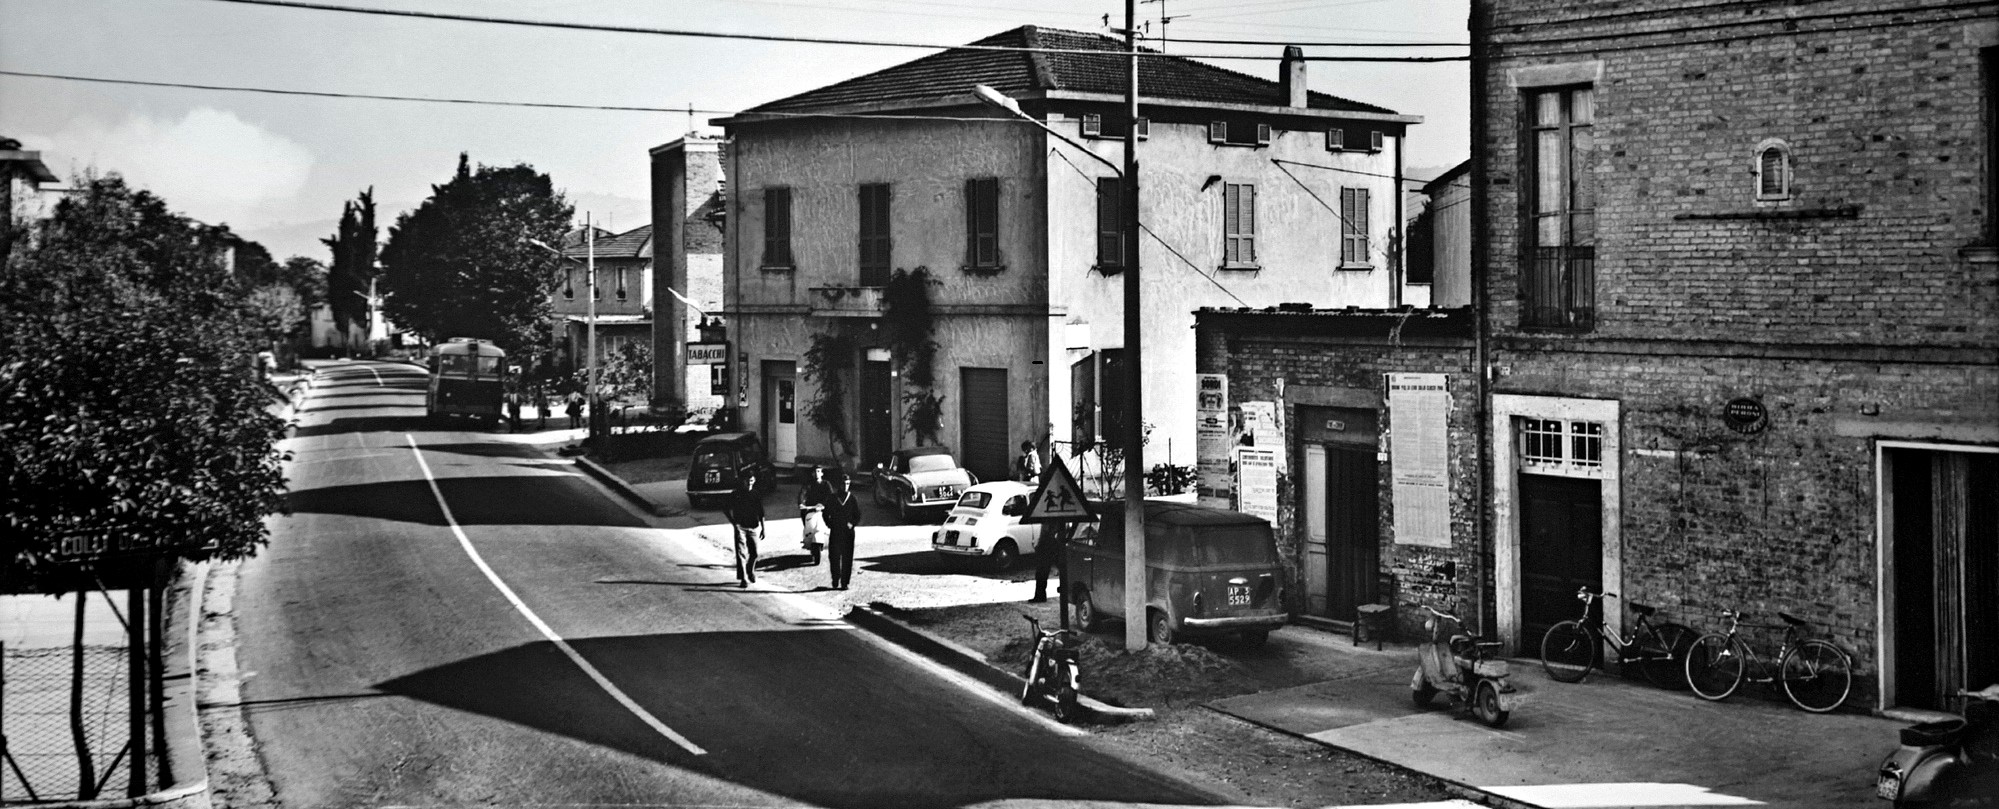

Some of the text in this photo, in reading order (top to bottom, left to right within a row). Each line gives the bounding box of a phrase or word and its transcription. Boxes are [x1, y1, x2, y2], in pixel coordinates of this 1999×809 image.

[689, 349, 725, 360] TABACCHI
[713, 365, 726, 385] T
[1730, 409, 1760, 417] PERONI
[1229, 587, 1239, 595] AP
[1229, 595, 1250, 605] 5529
